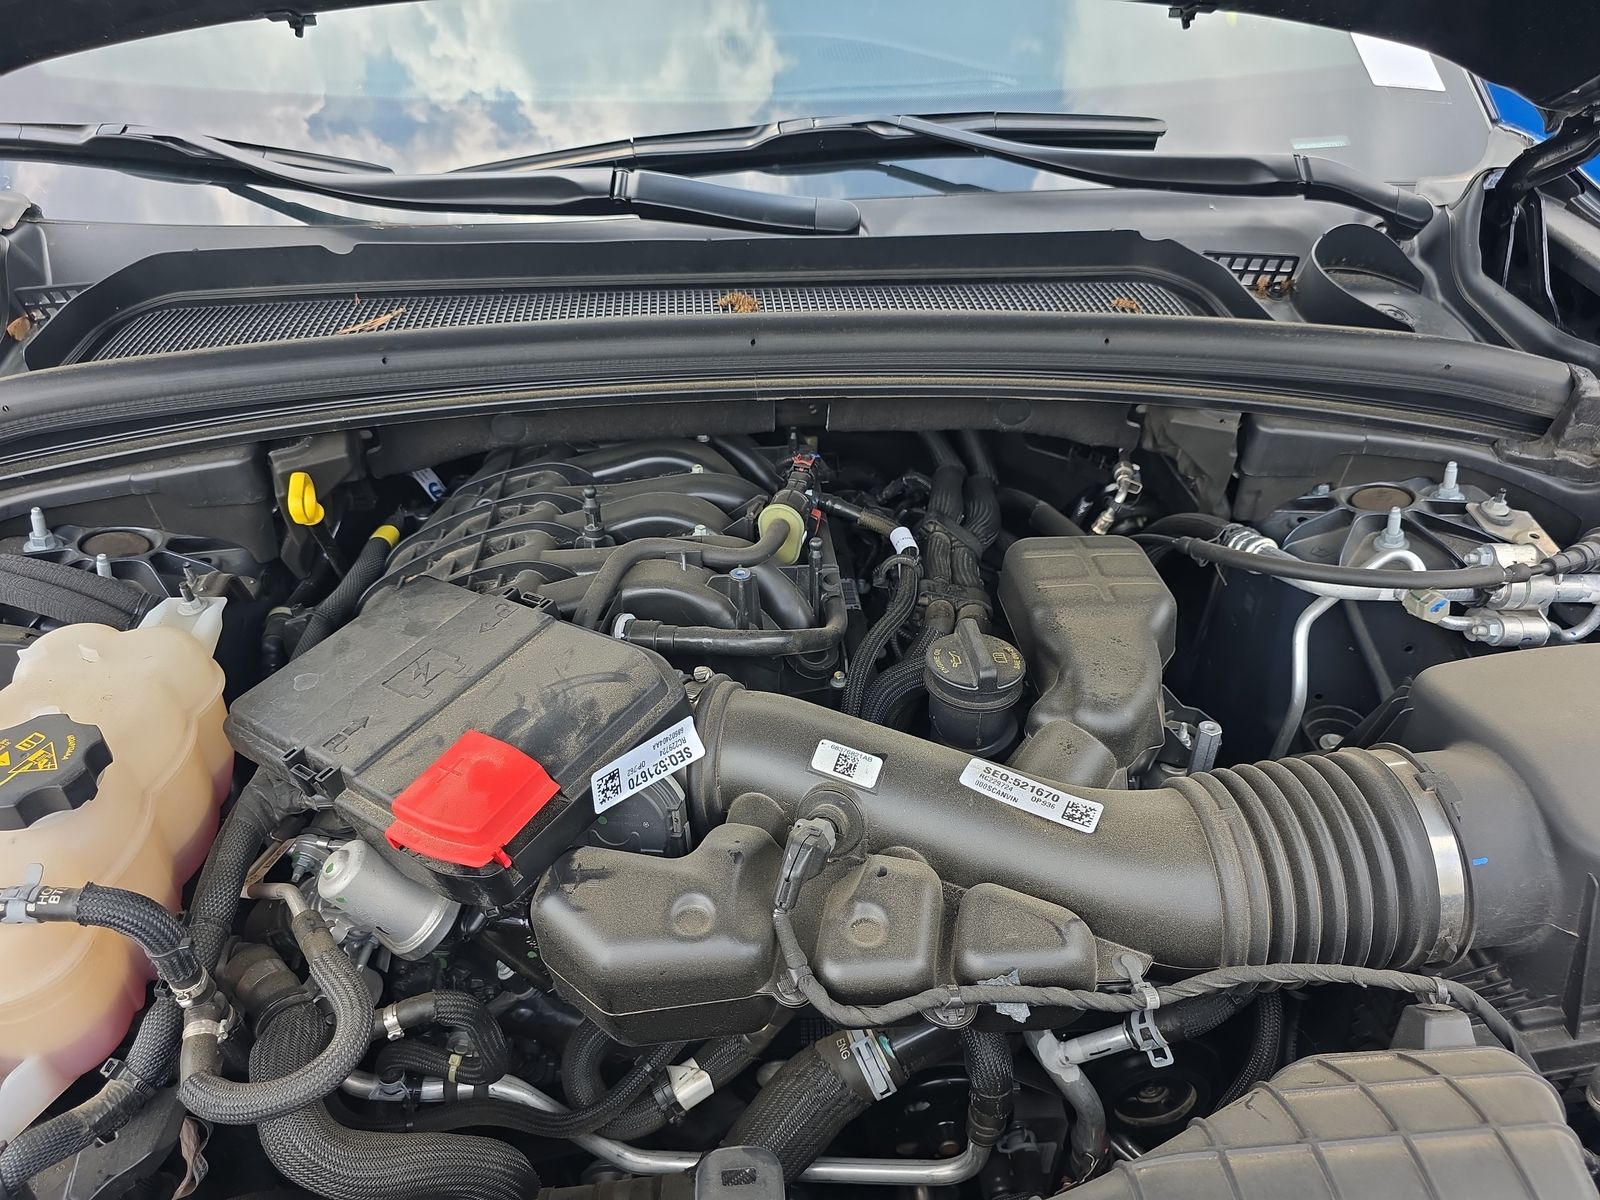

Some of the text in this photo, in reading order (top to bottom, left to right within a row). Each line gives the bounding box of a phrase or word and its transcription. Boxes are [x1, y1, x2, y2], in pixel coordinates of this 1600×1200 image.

[659, 736, 687, 757] RC229724
[830, 744, 873, 763] 68376821AB
[628, 746, 693, 790] SEQ:521670
[974, 780, 1019, 803] 000SCANVIN
[978, 773, 1014, 792] RC229724
[982, 766, 1060, 803] SEQ:521670
[836, 1037, 851, 1060] ENG
